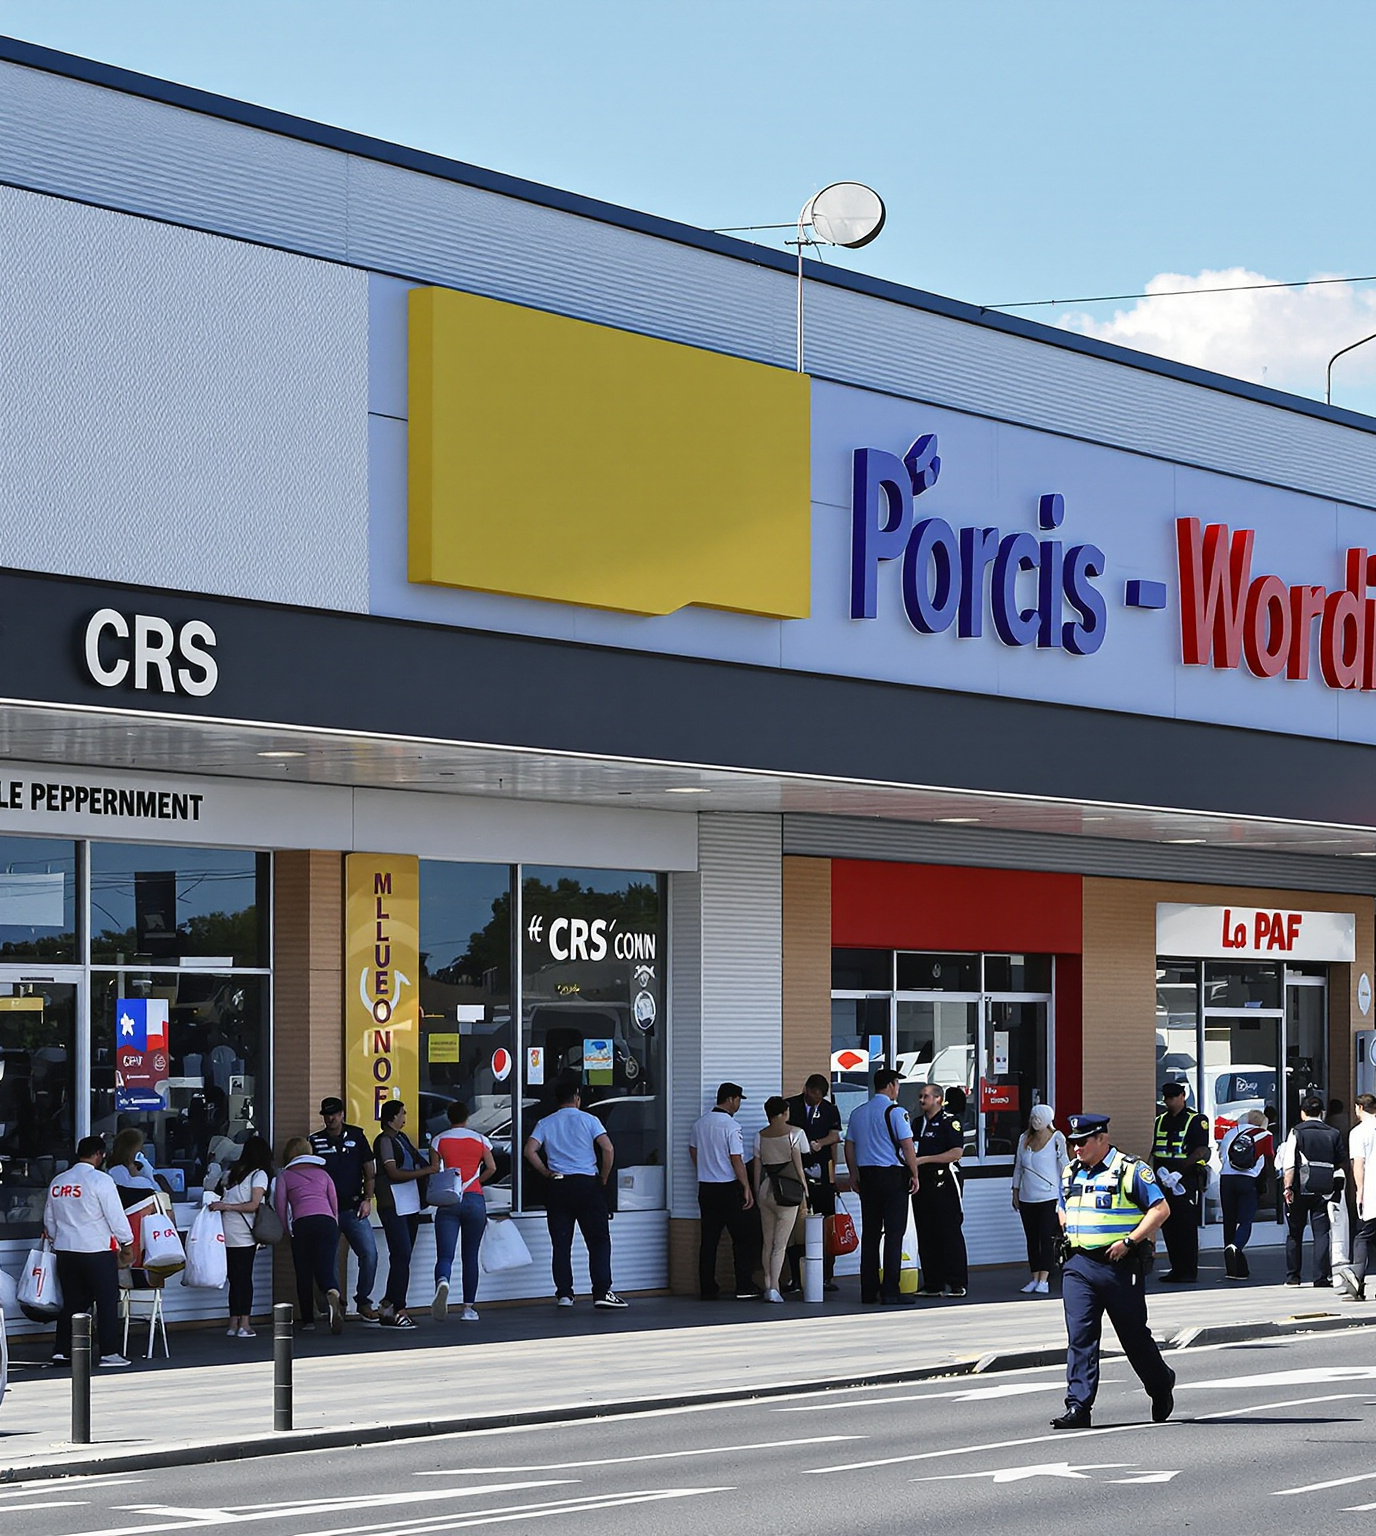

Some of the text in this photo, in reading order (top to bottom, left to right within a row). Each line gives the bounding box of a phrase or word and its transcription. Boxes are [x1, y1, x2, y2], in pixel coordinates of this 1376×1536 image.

[85, 608, 219, 697] CRS
[31, 782, 203, 821] PEPPERNMENT
[1254, 911, 1302, 951] PAF
